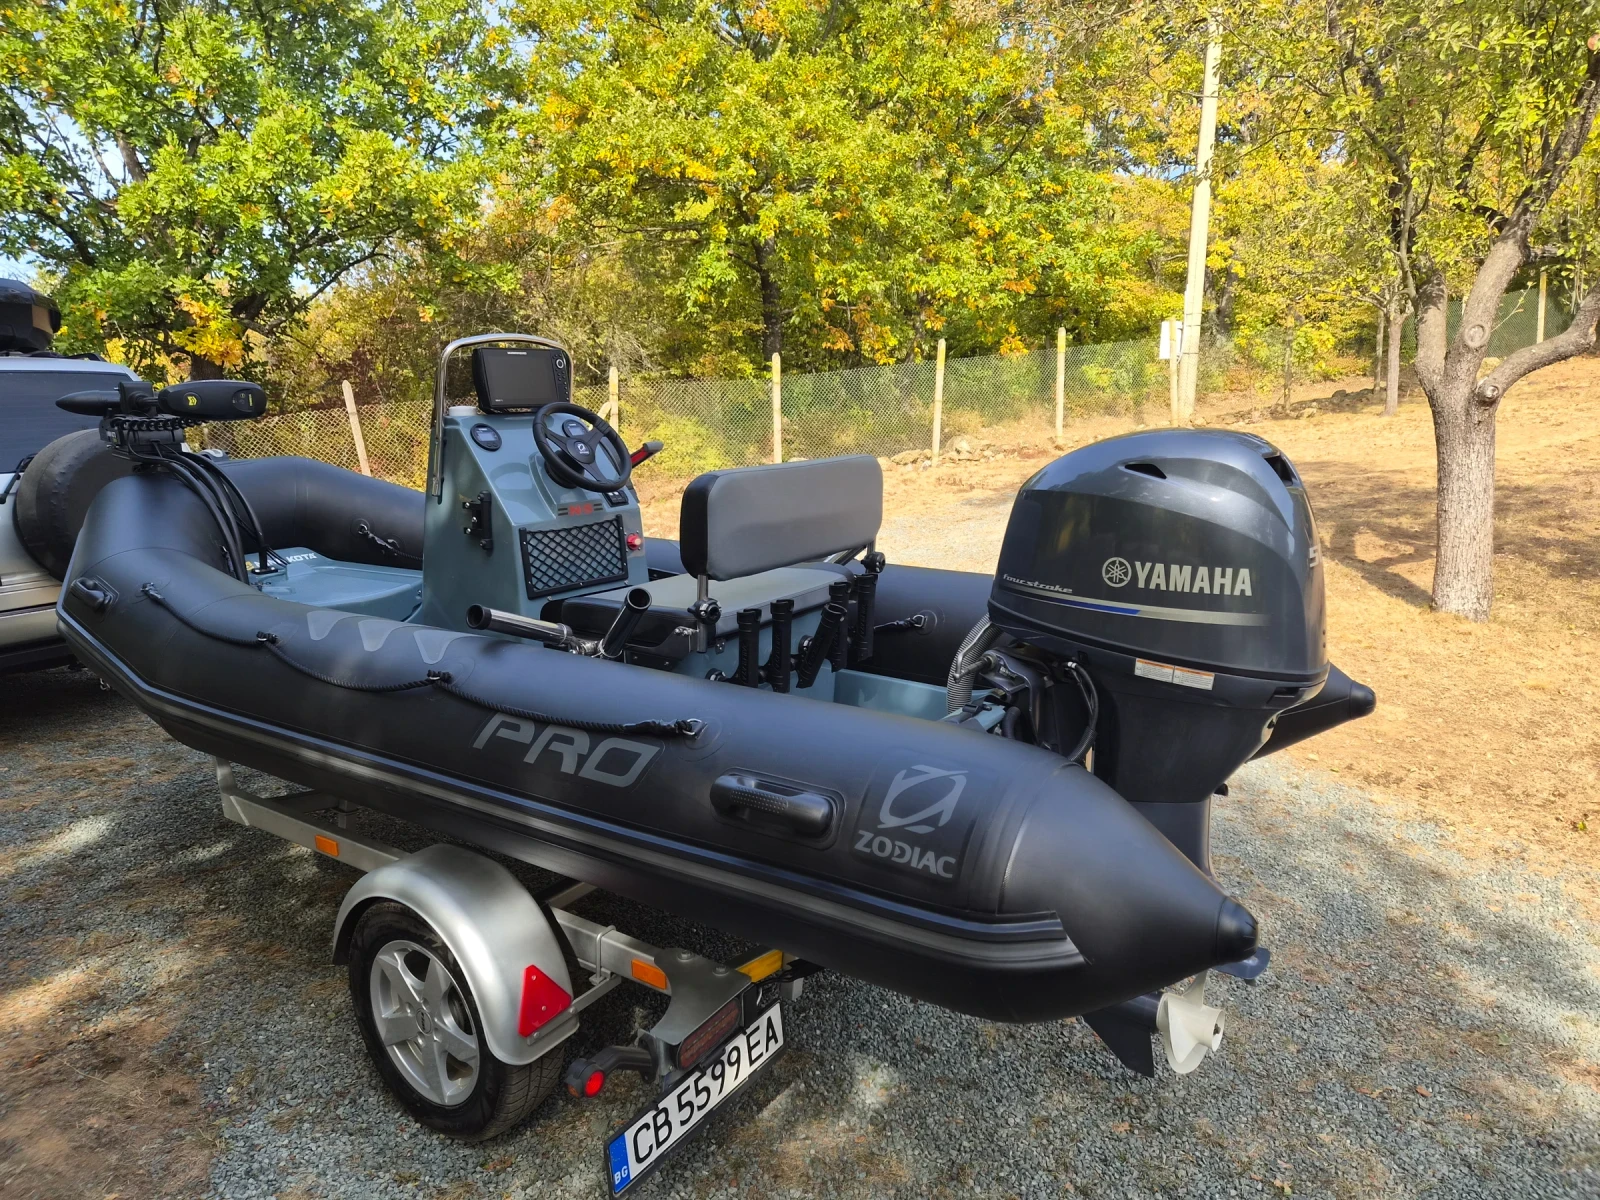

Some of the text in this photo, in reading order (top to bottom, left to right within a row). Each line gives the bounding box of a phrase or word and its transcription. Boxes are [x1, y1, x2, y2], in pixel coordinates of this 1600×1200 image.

[286, 553, 317, 563] KOTA
[1135, 561, 1252, 596] YAMAHA
[472, 713, 661, 788] PRO
[854, 830, 957, 878] ZODIAC
[614, 1166, 628, 1185] BG
